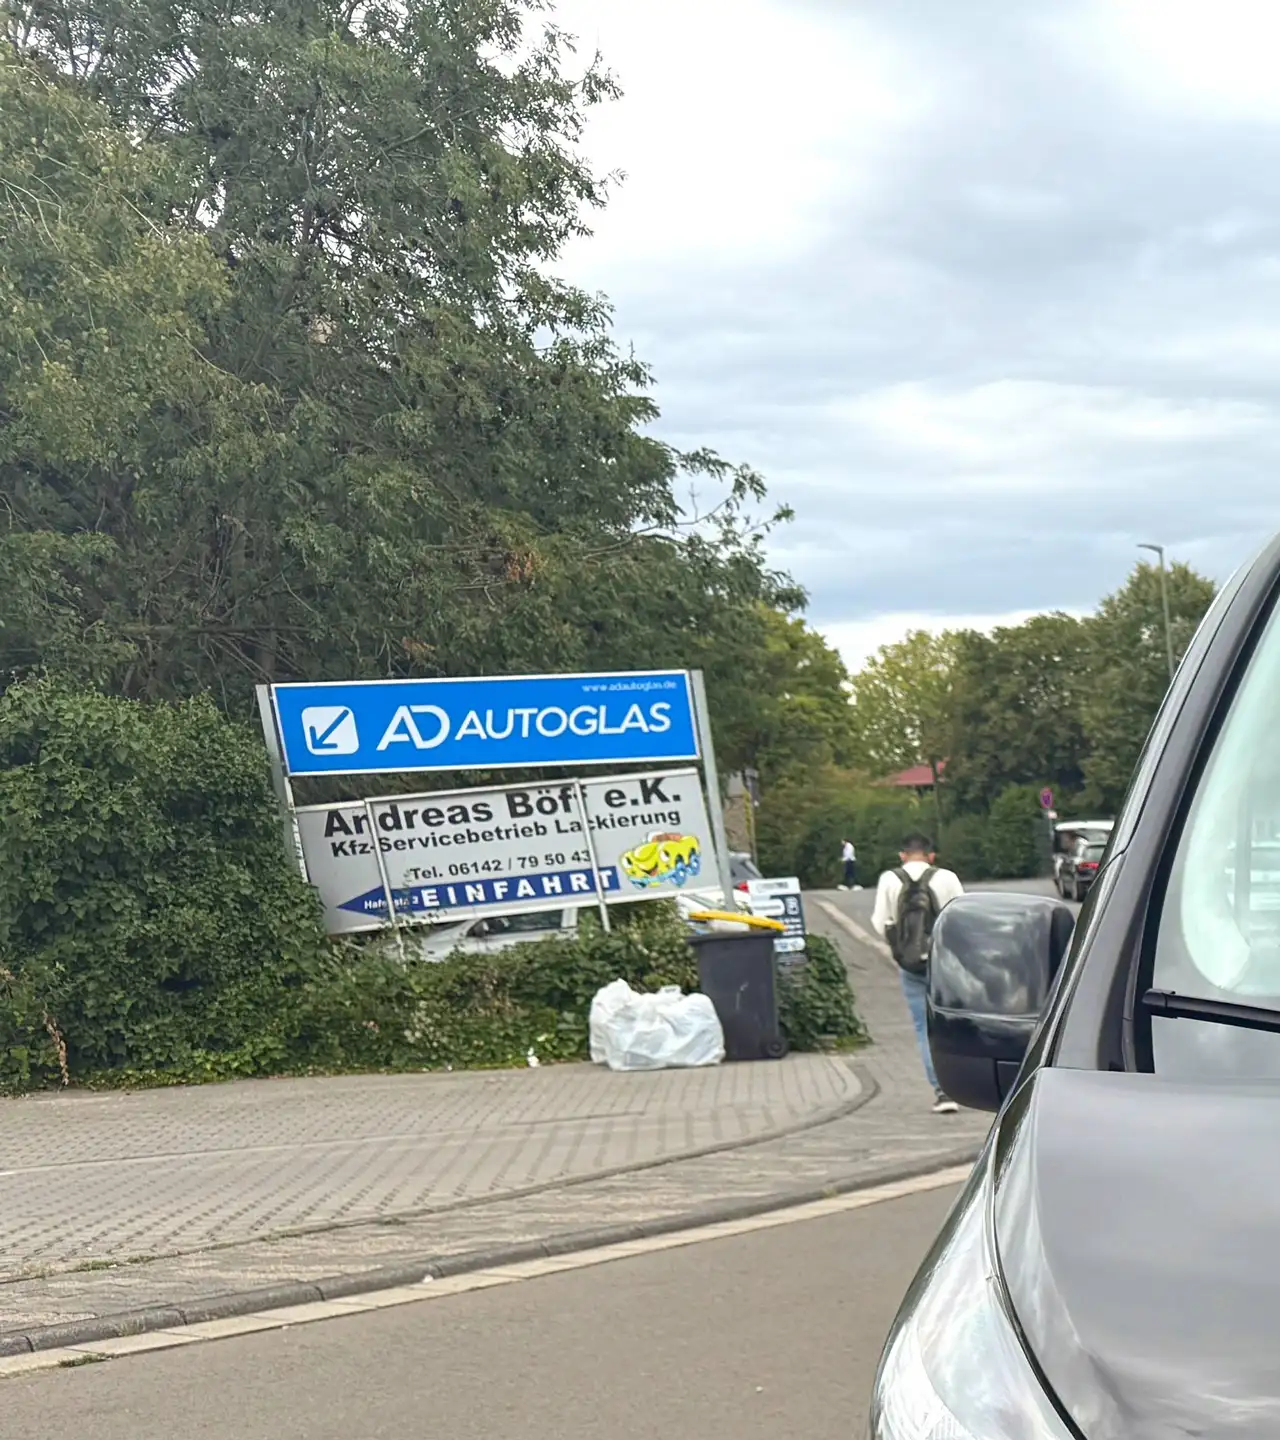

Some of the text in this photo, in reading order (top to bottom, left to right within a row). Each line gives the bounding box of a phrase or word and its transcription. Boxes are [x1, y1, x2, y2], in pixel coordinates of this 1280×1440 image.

[376, 702, 671, 751] AD AUTOGLAS
[324, 802, 493, 838] Andreas
[604, 777, 682, 808] e.K.
[330, 822, 547, 858] Kfz-Servicebetrieb
[555, 810, 682, 834] Lackierung
[410, 866, 443, 881] Tel.
[449, 859, 503, 877] 06142
[516, 855, 539, 870] 79
[544, 852, 565, 867] 50
[571, 849, 592, 863] 43
[421, 869, 613, 908] EINFAHRT
